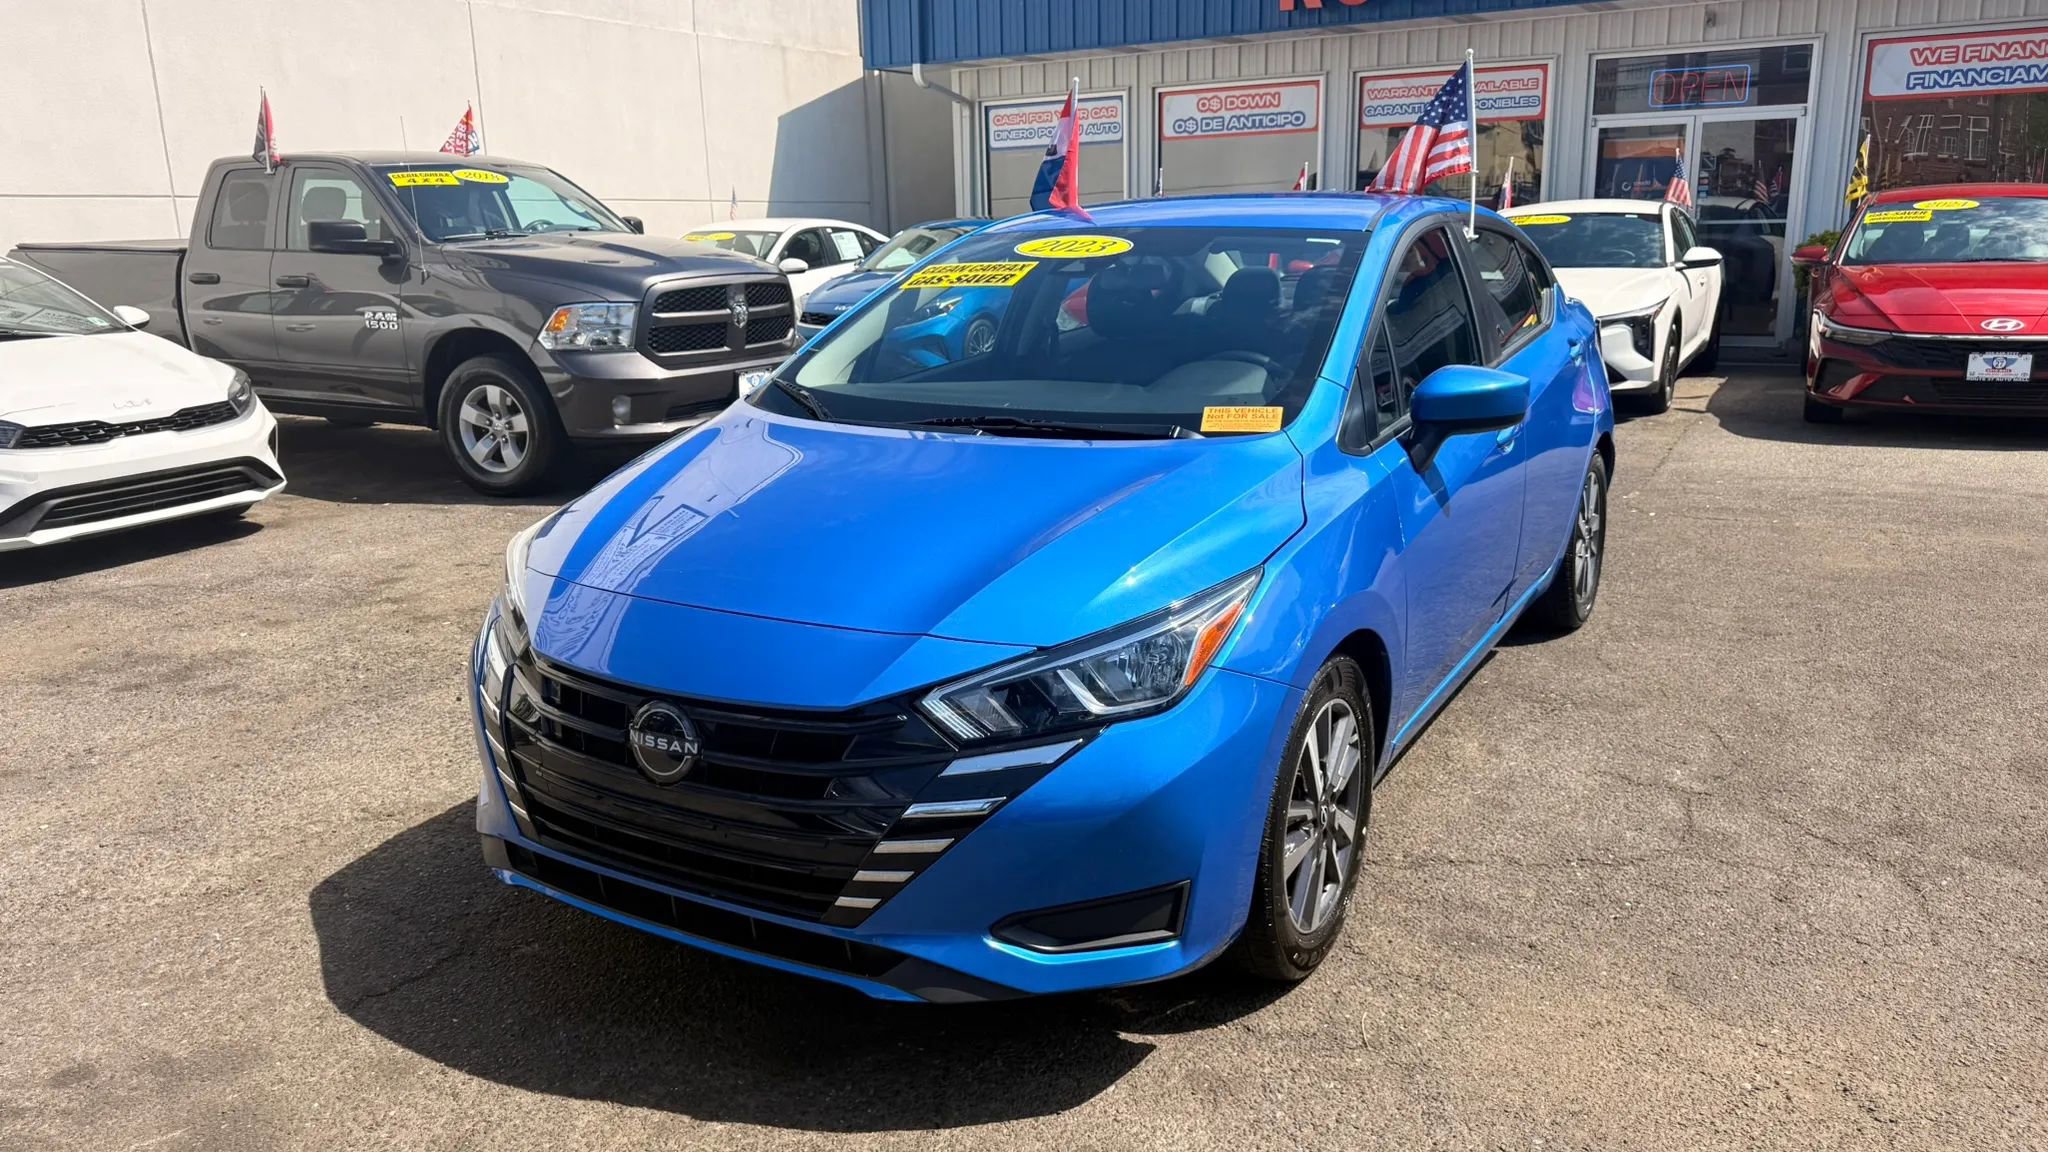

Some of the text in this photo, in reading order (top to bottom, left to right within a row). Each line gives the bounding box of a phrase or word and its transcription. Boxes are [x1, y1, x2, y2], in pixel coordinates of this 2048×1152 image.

[1911, 38, 2048, 66] WE FINAN
[1368, 84, 1442, 100] WARRANT
[1653, 70, 1747, 103] OPEN
[1224, 92, 1280, 110] DOWN
[1364, 101, 1429, 117] GARANTI
[993, 112, 1026, 126] CASH
[1028, 110, 1052, 122] FOR
[1090, 106, 1117, 119] CAR
[1200, 115, 1224, 132] DE
[1226, 111, 1305, 130] ANTICIPO
[994, 126, 1035, 141] DINERO
[1038, 125, 1057, 138] PO
[1085, 121, 1120, 135] AUTO
[1030, 240, 1117, 253] 2023
[921, 263, 1031, 274] CLEAN CARFAX
[909, 273, 1014, 286] GAS-SAVER
[364, 311, 397, 321] RAM
[365, 320, 398, 330] 1500
[629, 729, 698, 754] NISSAN
